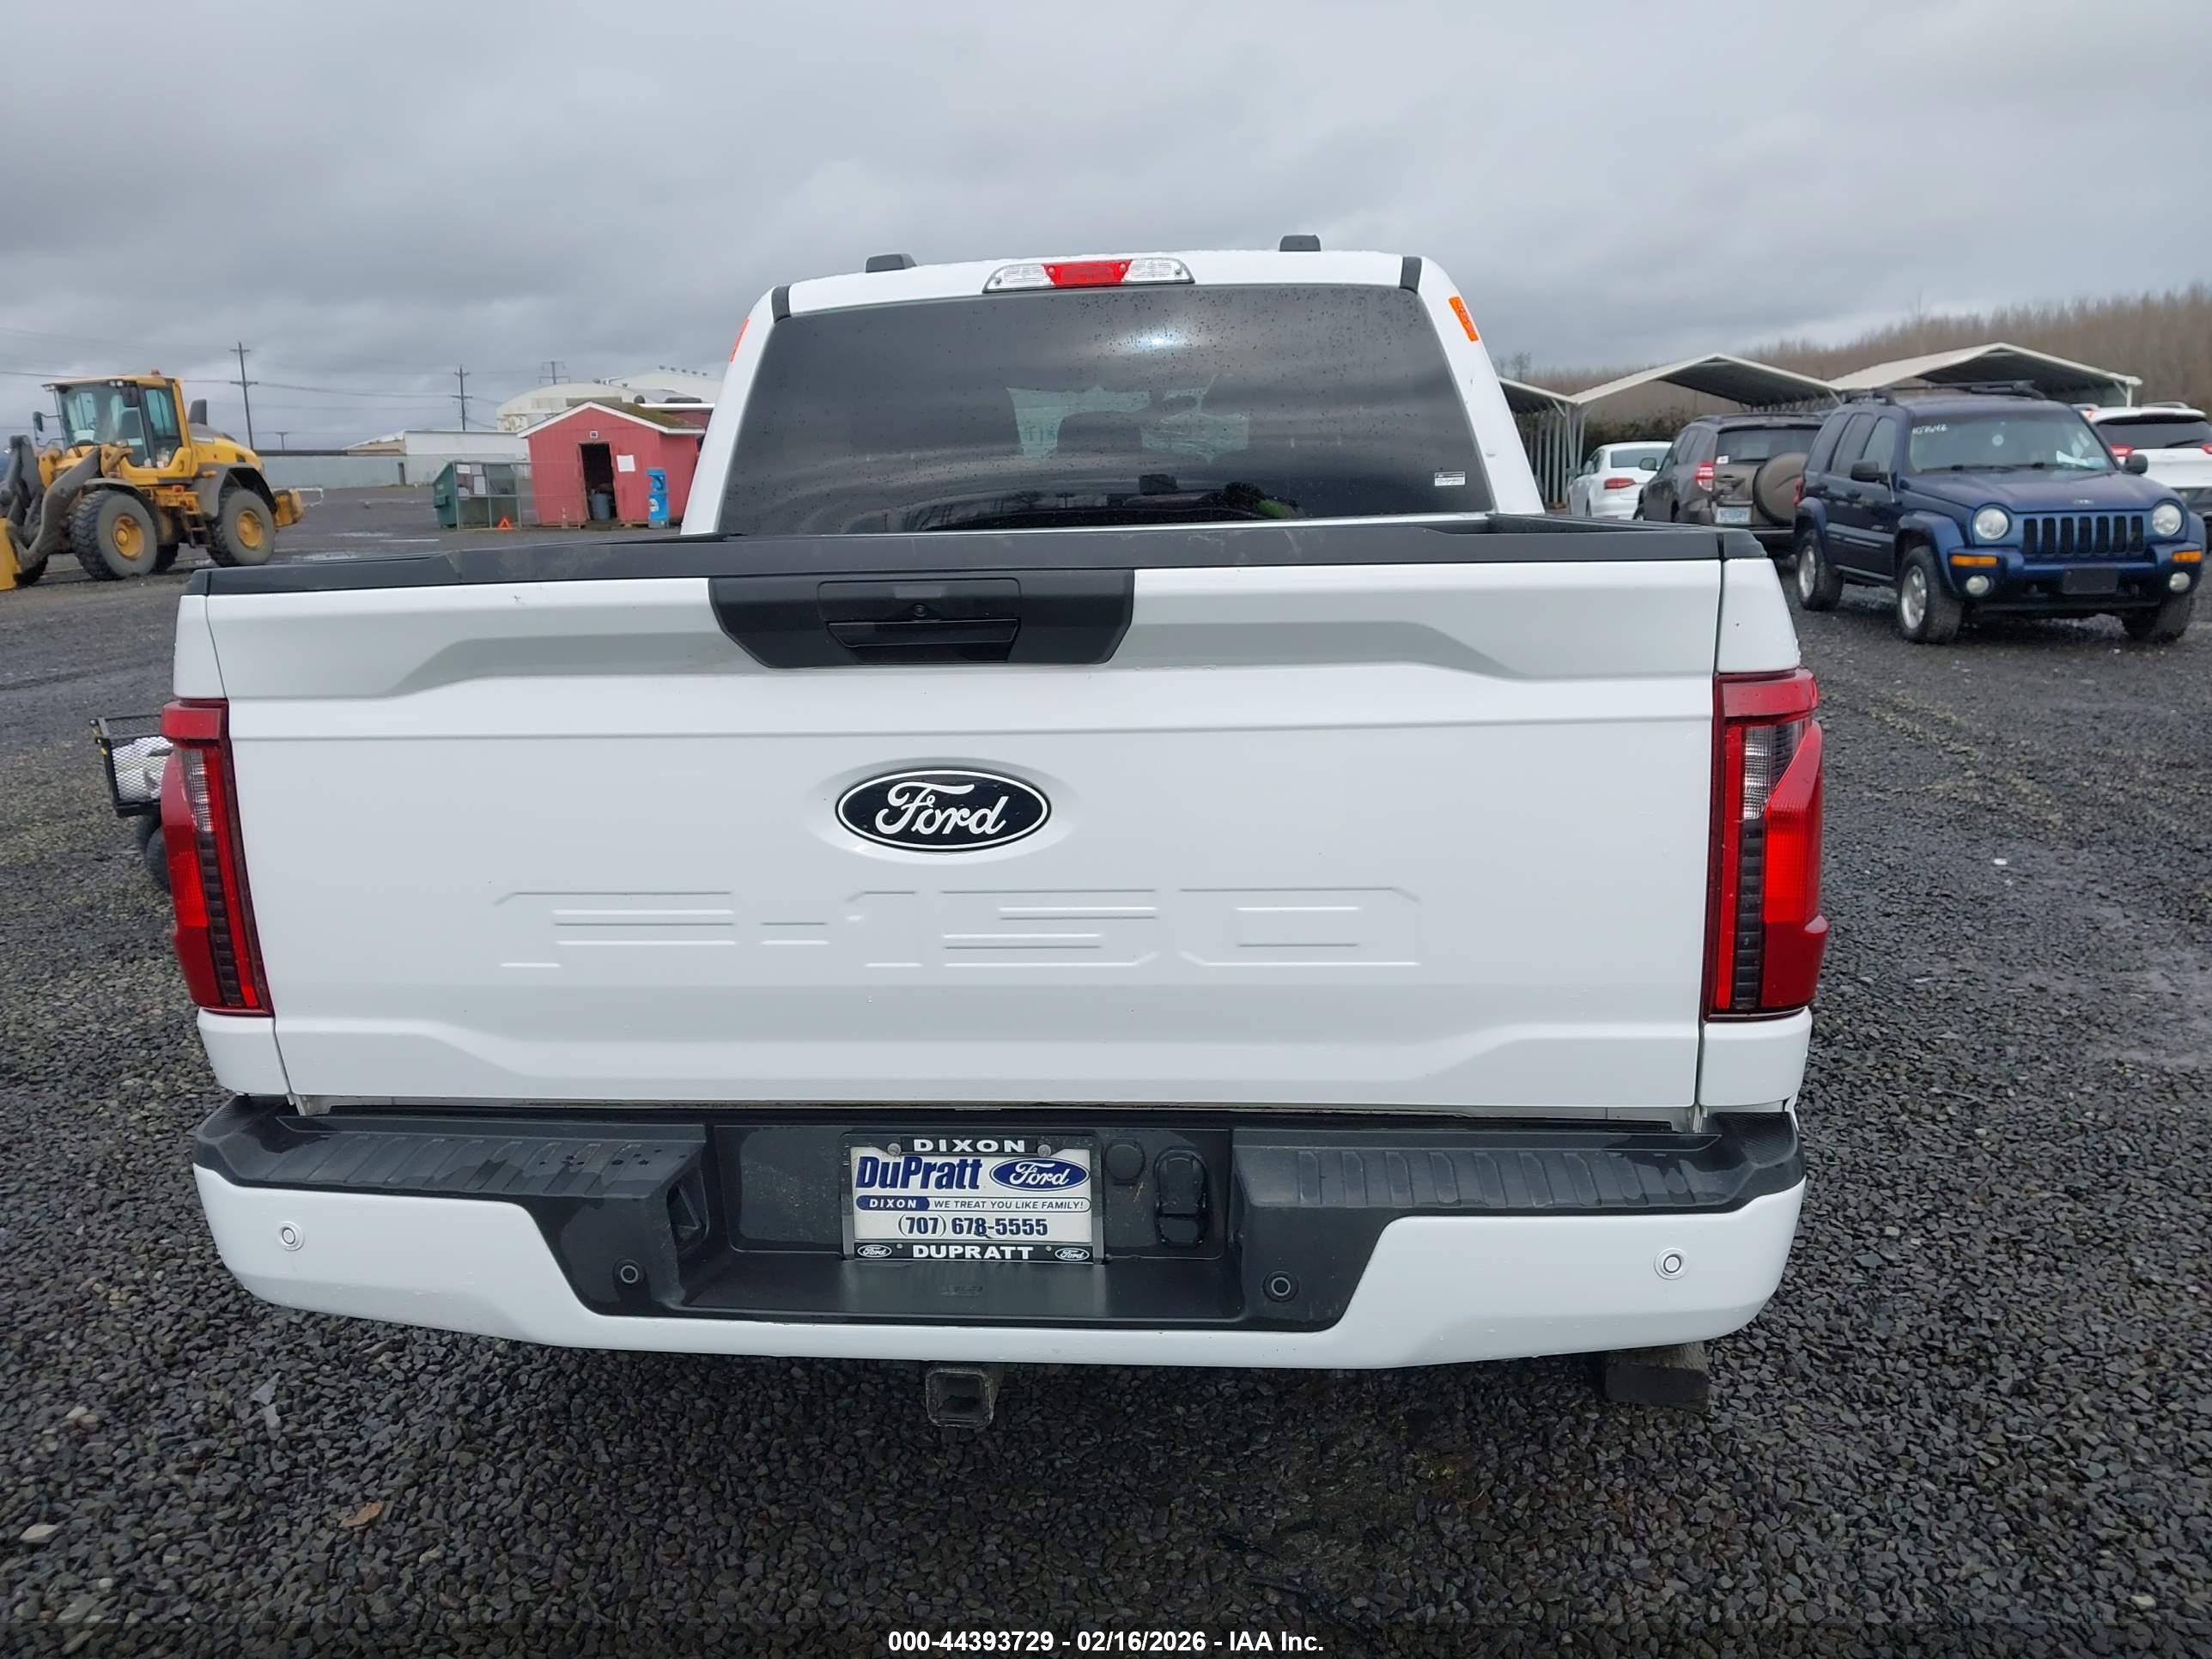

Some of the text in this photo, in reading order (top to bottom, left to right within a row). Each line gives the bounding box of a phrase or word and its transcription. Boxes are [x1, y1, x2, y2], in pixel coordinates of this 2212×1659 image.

[875, 781, 1009, 835] Ford
[913, 1139, 1025, 1152] DIXON
[856, 1156, 983, 1190] DuPratt
[1009, 1161, 1071, 1186] Ford
[869, 1199, 917, 1209] DIXON
[933, 1200, 1084, 1210] WE TREAT YOU LIKE FAMILY!
[898, 1213, 1048, 1237] (707) 678-5555
[912, 1244, 1034, 1260] DUPRATT
